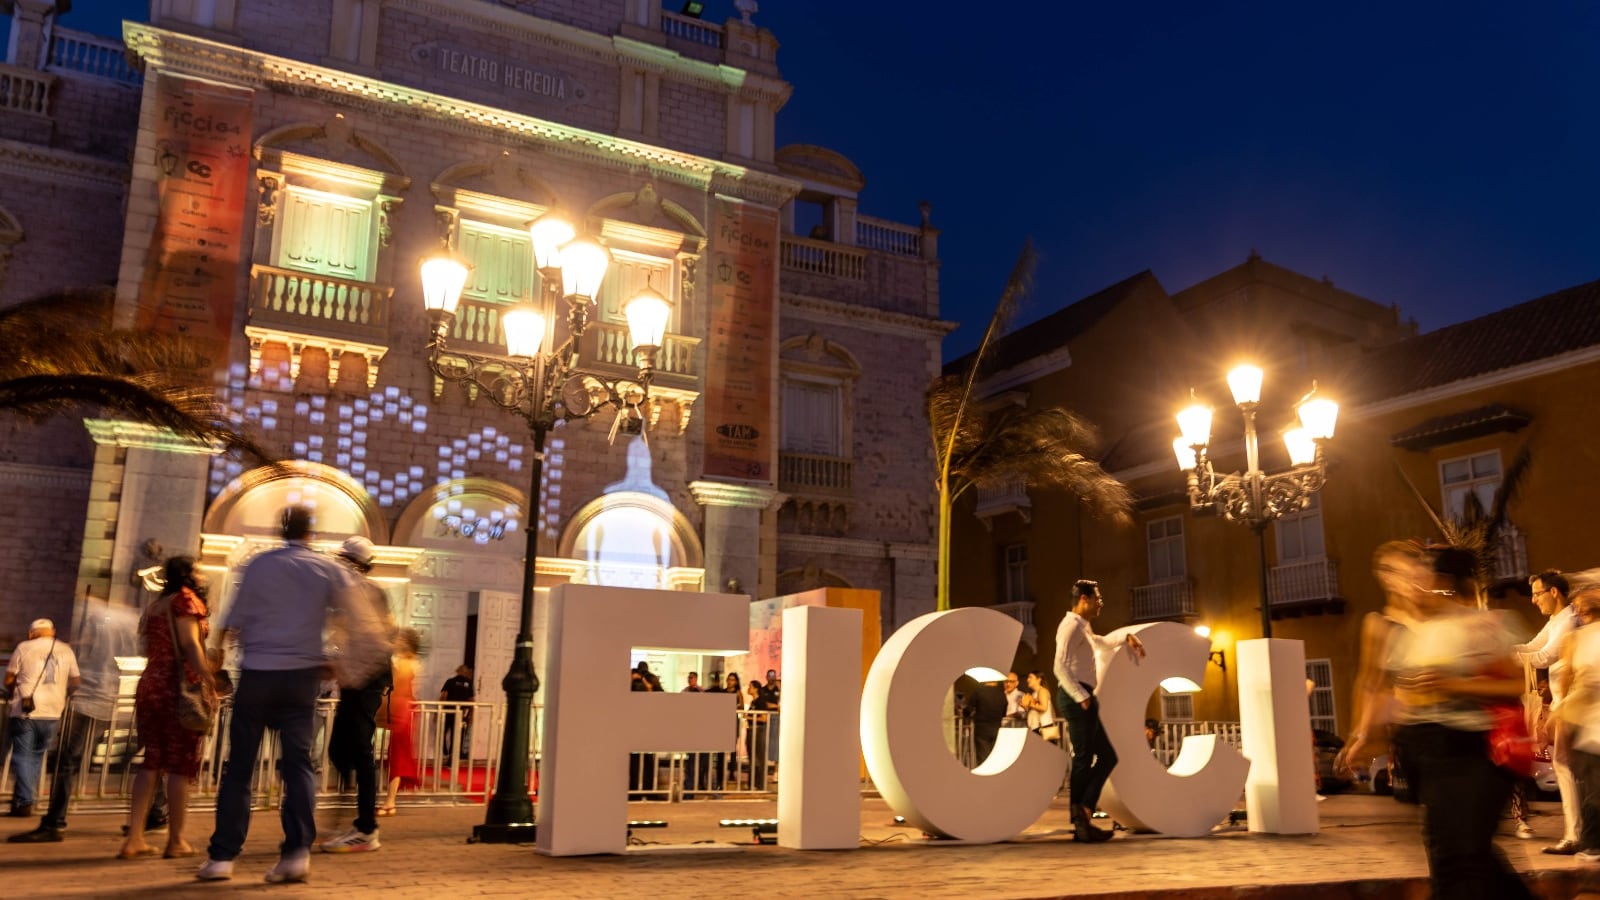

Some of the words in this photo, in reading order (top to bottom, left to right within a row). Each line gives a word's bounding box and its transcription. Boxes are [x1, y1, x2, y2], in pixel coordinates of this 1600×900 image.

[441, 49, 498, 82] TEATRO
[504, 64, 565, 99] HEREDIA
[726, 424, 752, 440] TAM
[535, 583, 1320, 857] FICCI
